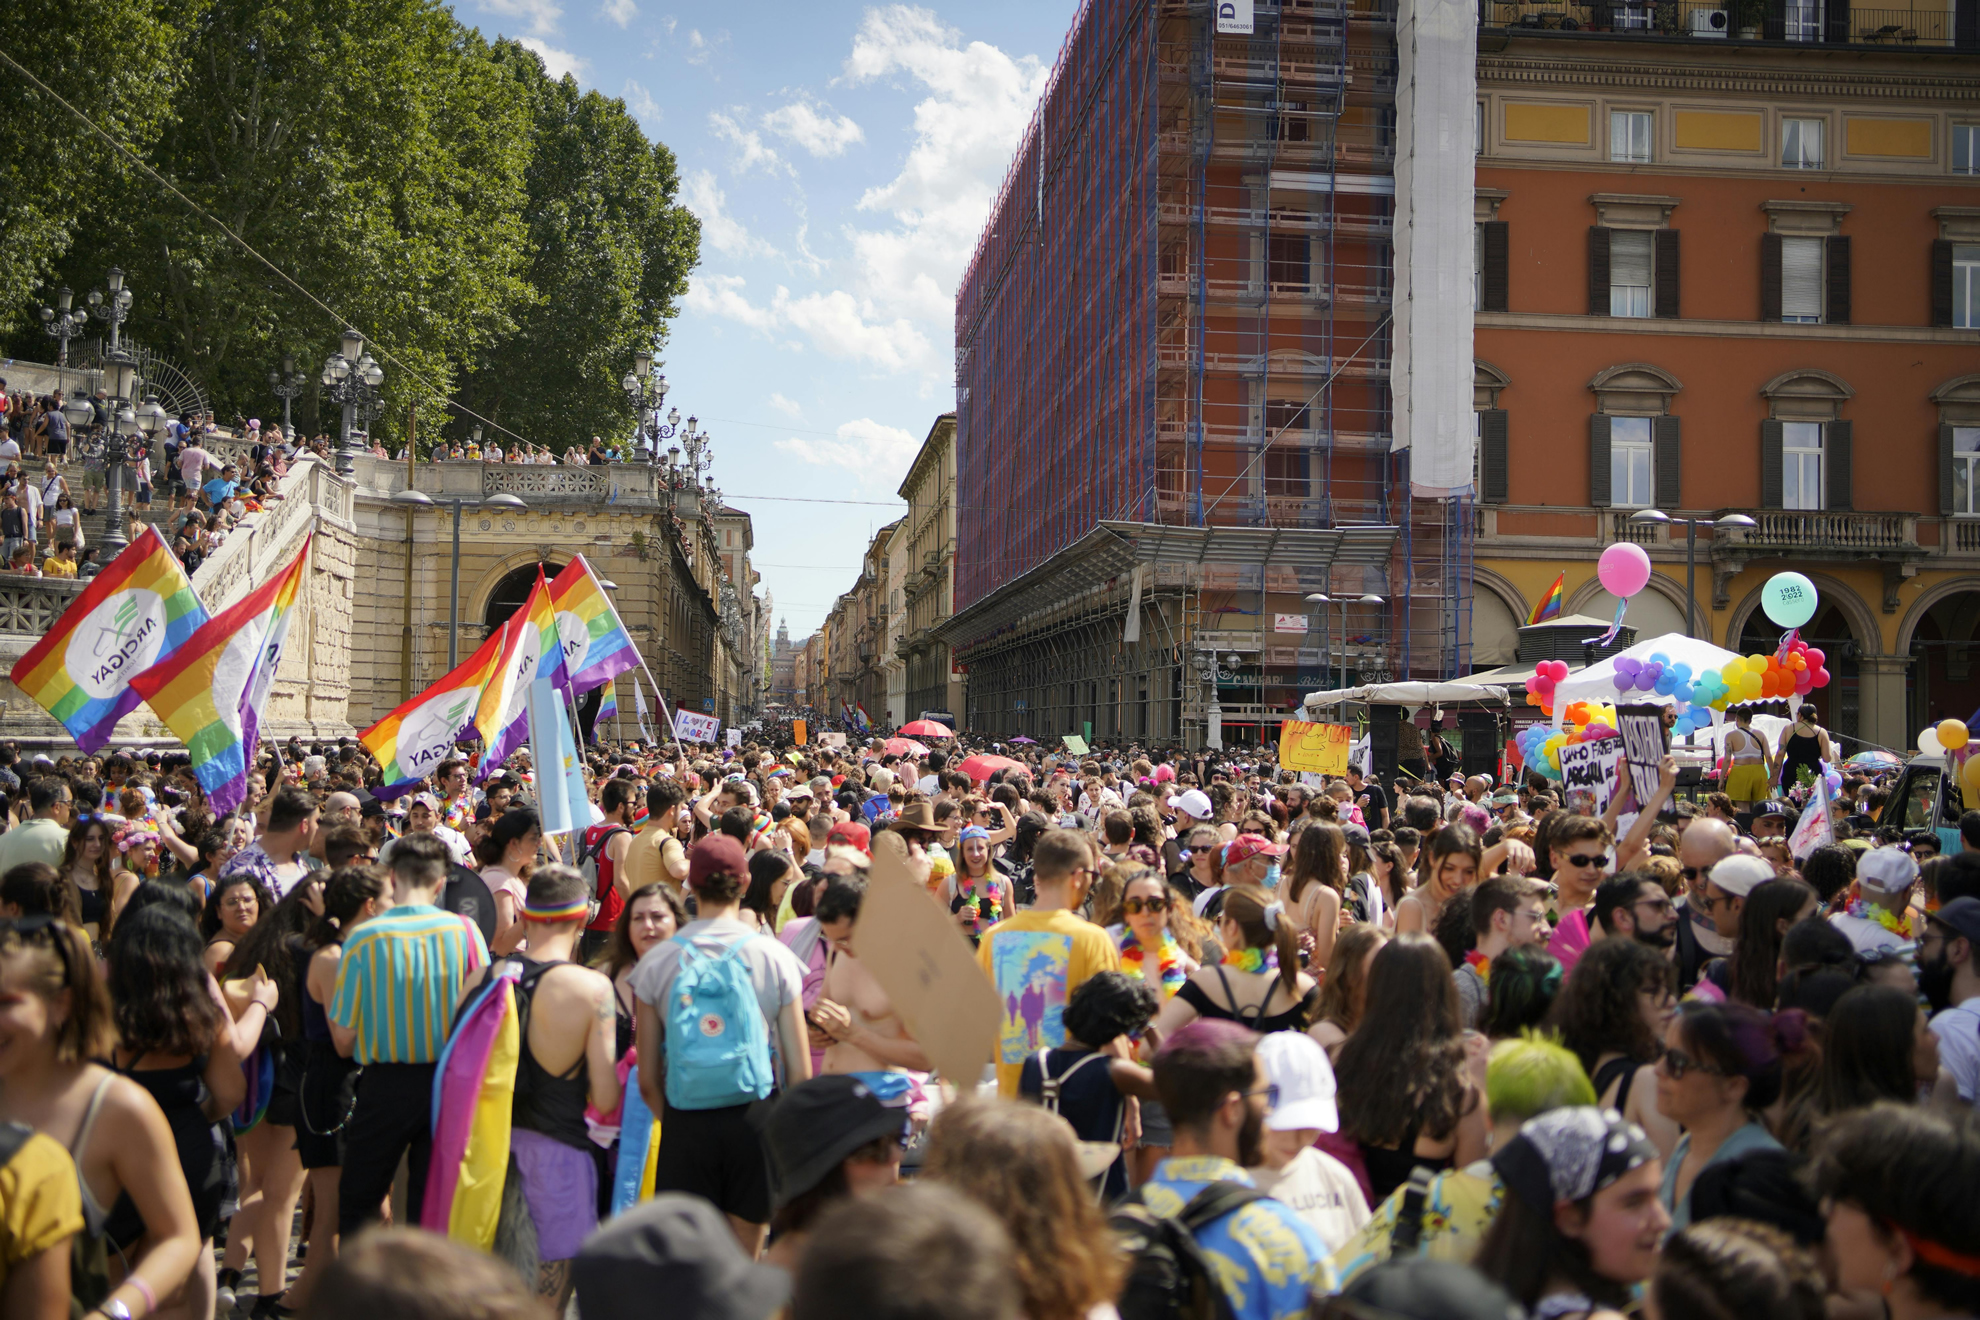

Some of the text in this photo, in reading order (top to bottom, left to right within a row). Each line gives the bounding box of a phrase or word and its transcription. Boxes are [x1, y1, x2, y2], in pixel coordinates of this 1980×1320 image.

[1780, 585, 1801, 594] 1982
[1781, 591, 1803, 600] 2022
[1233, 675, 1283, 687] CAMPARI
[681, 727, 709, 739] MORE
[1765, 802, 1783, 813] NY
[1292, 1192, 1345, 1211] LUCIA
